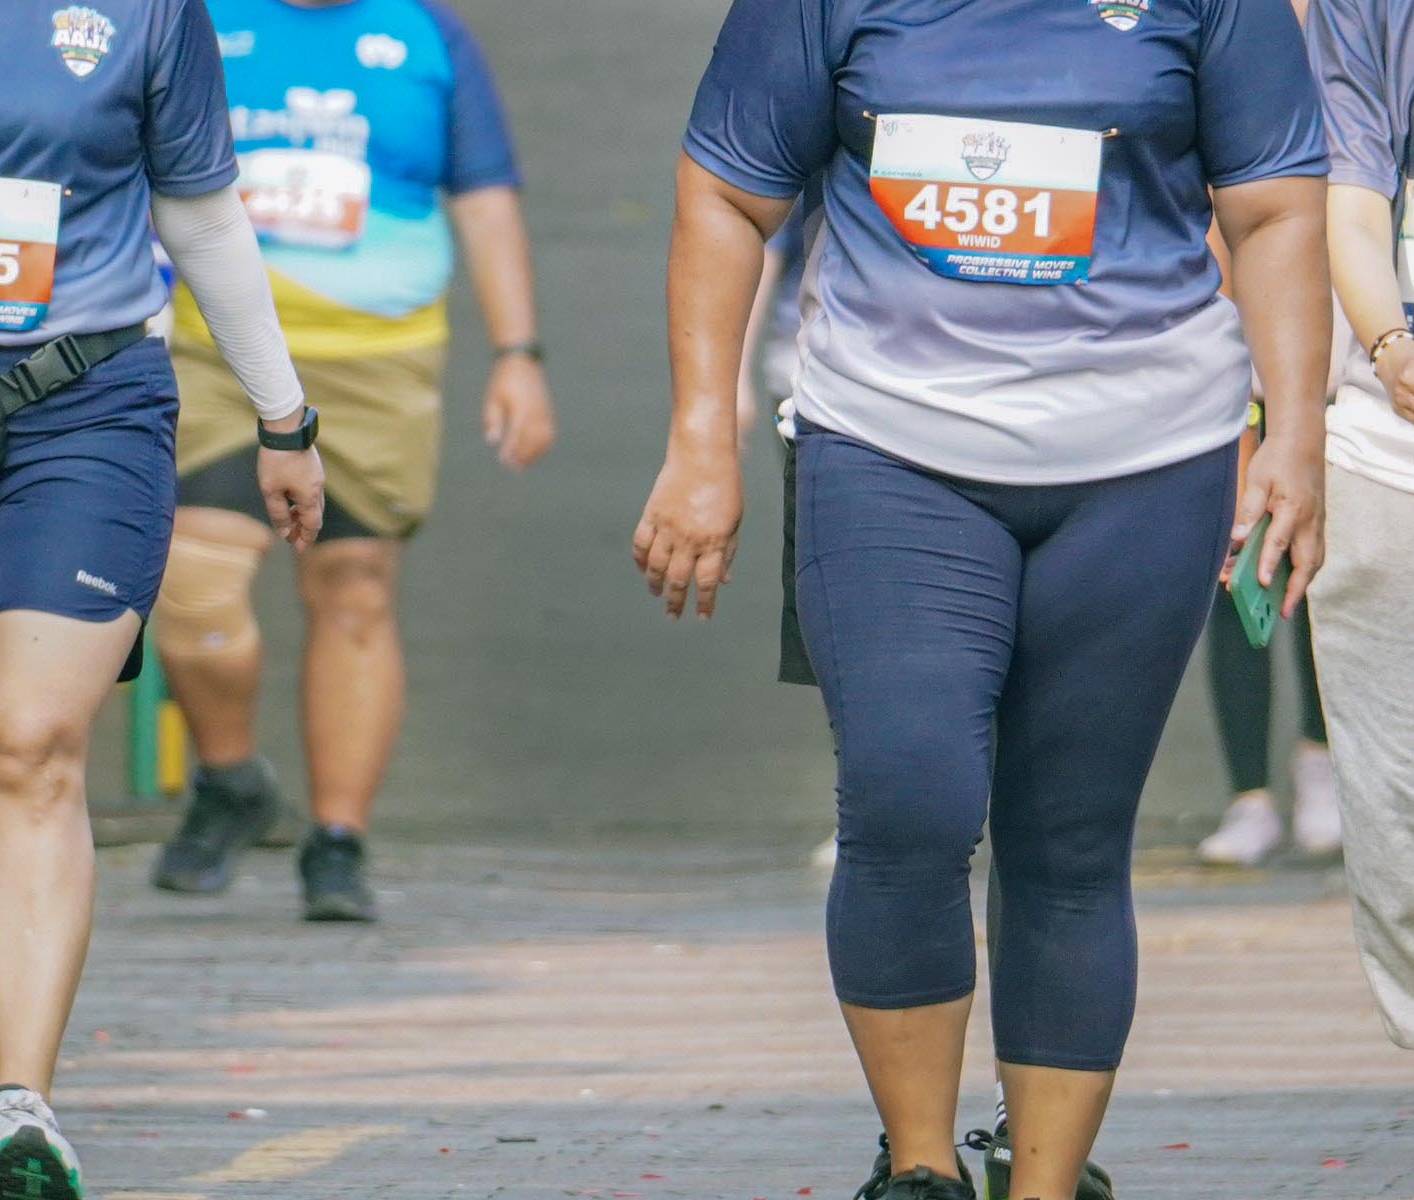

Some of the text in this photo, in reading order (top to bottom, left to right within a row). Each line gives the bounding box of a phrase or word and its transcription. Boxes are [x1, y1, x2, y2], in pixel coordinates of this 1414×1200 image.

[904, 183, 1052, 237] 4581
[957, 234, 1001, 248] WIWID
[946, 254, 1075, 270] PROGRESSIVE MOVES
[959, 266, 1062, 280] COLLECTIVE WINS
